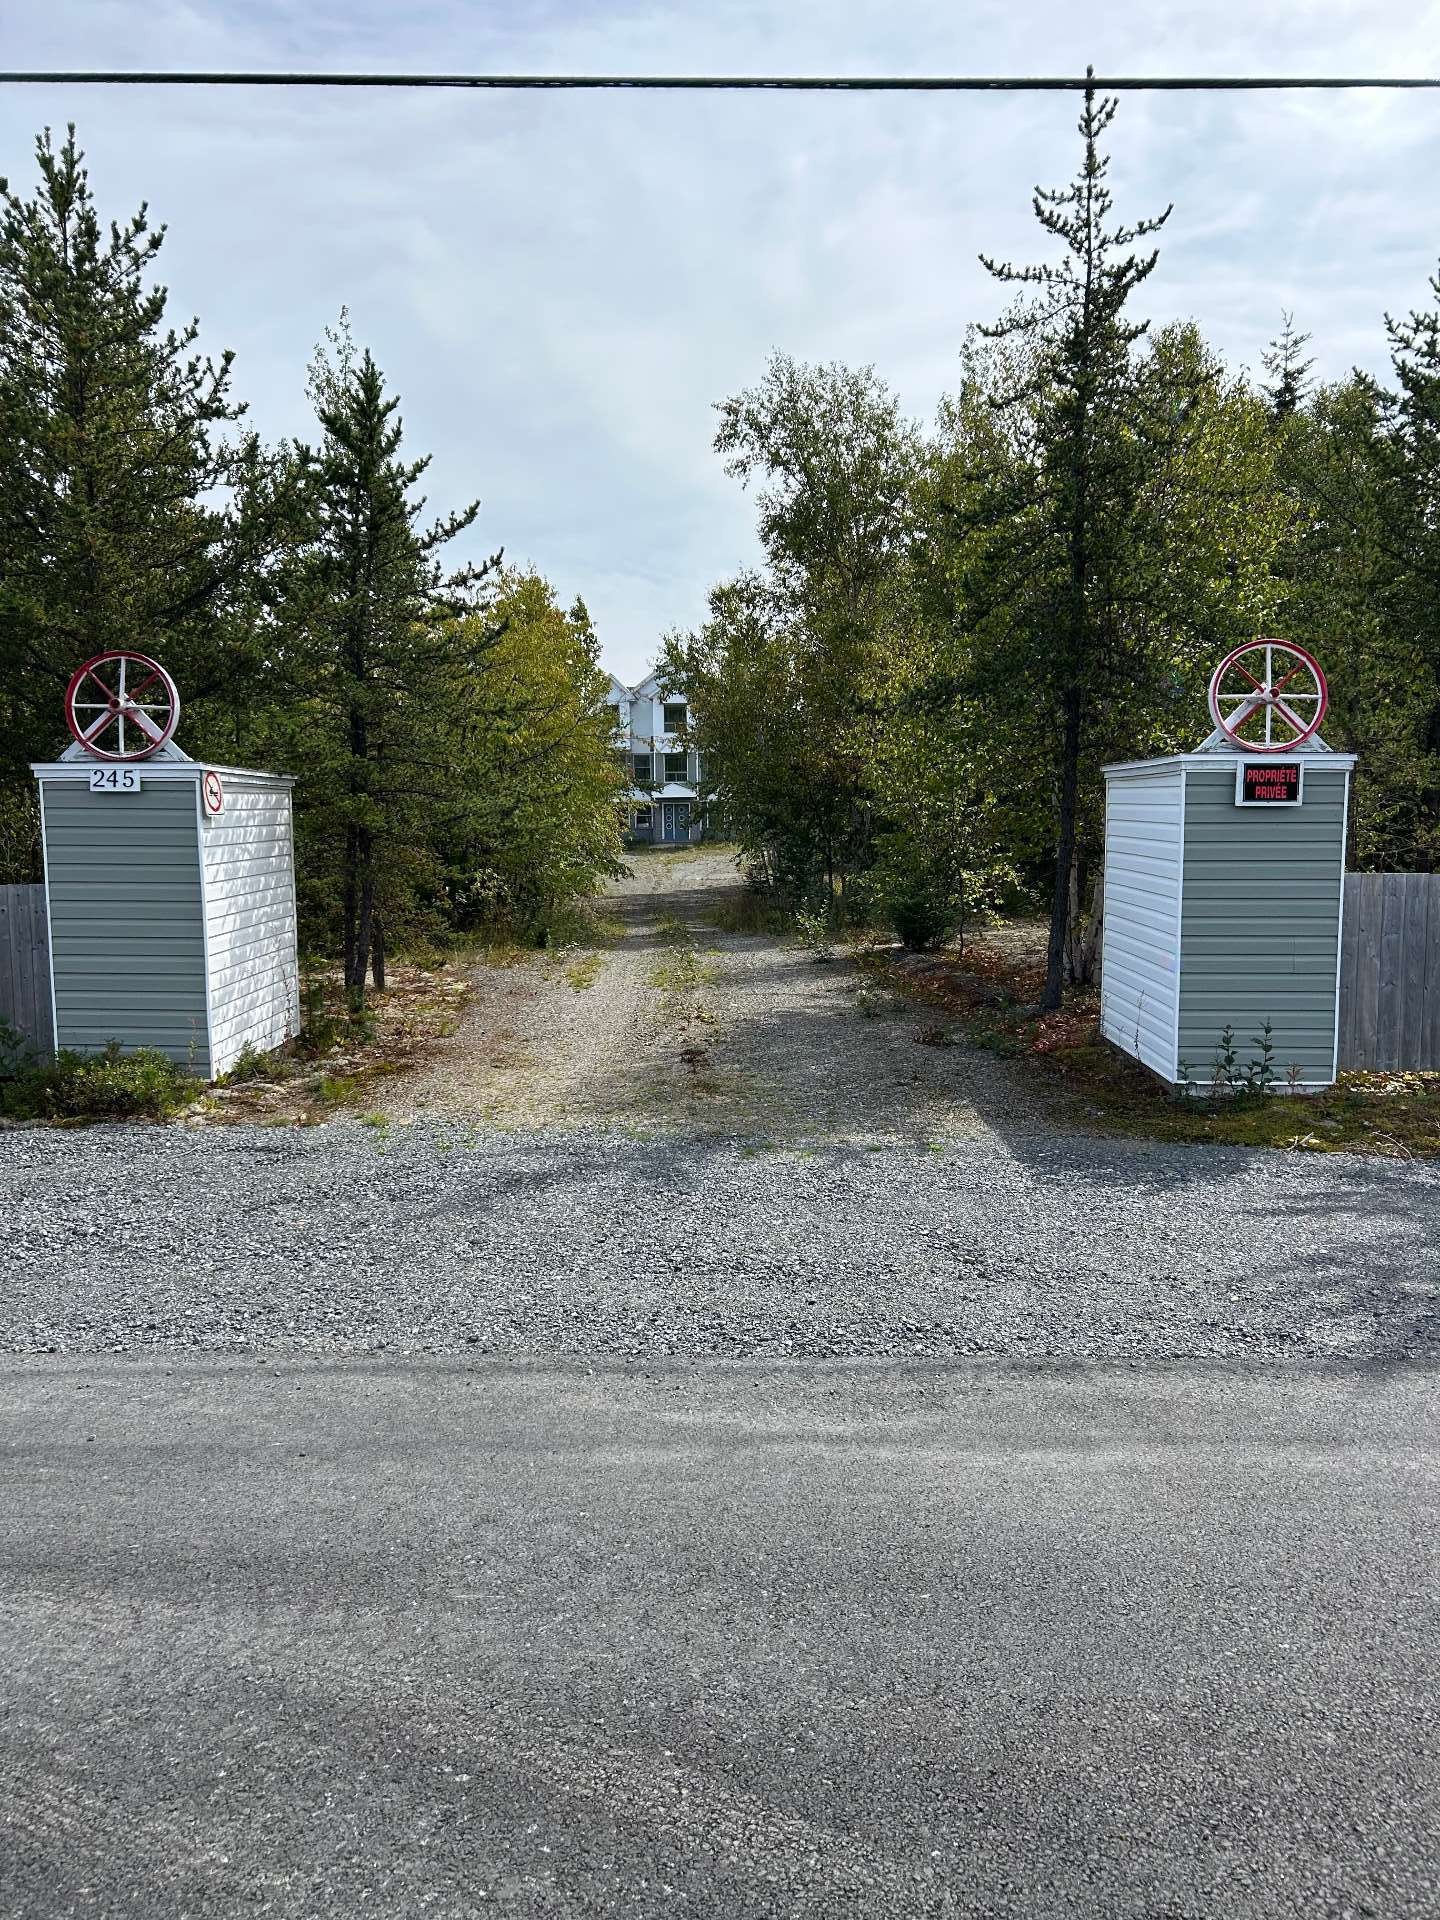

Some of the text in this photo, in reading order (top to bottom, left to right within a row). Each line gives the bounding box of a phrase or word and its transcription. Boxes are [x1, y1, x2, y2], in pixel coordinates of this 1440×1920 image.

[92, 769, 135, 788] 245
[1246, 766, 1297, 783] PROPRIÉTÉ
[1255, 783, 1288, 799] PRIVÉE
